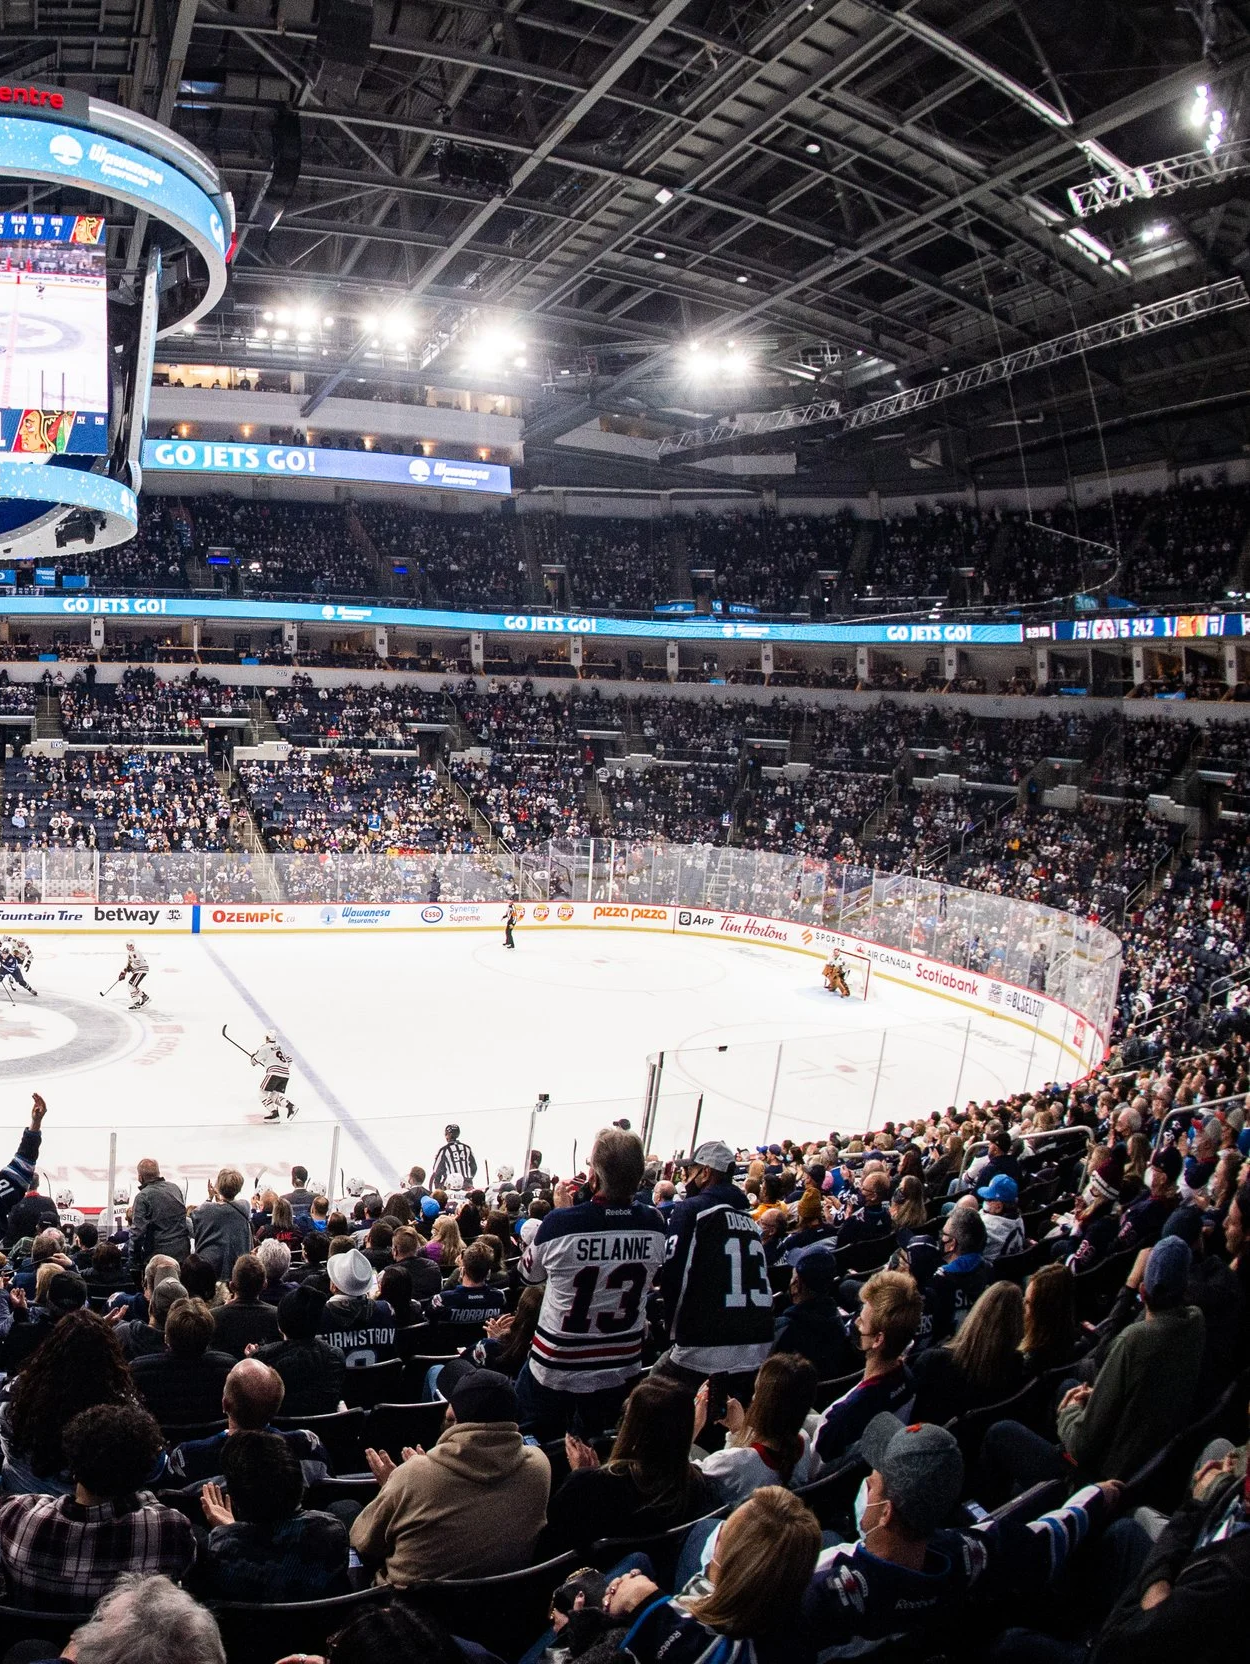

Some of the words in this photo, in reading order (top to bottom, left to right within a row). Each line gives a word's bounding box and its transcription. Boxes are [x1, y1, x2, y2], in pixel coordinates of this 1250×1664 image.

[13, 224, 25, 235] 14
[154, 443, 198, 466] GO
[202, 445, 260, 469] JETS
[266, 448, 317, 473] GO!
[63, 598, 89, 613] GO
[92, 598, 130, 614] JETS
[134, 598, 166, 614] GO!
[504, 616, 528, 629] GO
[530, 616, 564, 631] JETS
[567, 618, 596, 633] GO!
[1120, 619, 1129, 638] 5
[1164, 618, 1172, 636] 1
[886, 625, 908, 640] GO
[911, 625, 942, 642] JETS
[944, 625, 972, 641] GO!
[58, 910, 83, 921] Tire
[94, 907, 160, 925] betway
[342, 907, 391, 918] Wawanesa
[424, 909, 441, 919] Esso
[449, 904, 479, 916] Synergy
[594, 906, 629, 920] pizza
[631, 907, 667, 921] pizza
[348, 916, 379, 924] Insurance
[720, 914, 743, 933] Tim
[744, 918, 788, 942] Hortons
[815, 931, 846, 947] SPORTS
[866, 949, 879, 961] AIR
[880, 952, 911, 971] CANADA
[915, 963, 978, 996] Scotiabank
[605, 1208, 632, 1217] Reebok
[577, 1237, 653, 1261] SELANNE
[725, 1238, 773, 1307] 13
[562, 1262, 648, 1334] 13
